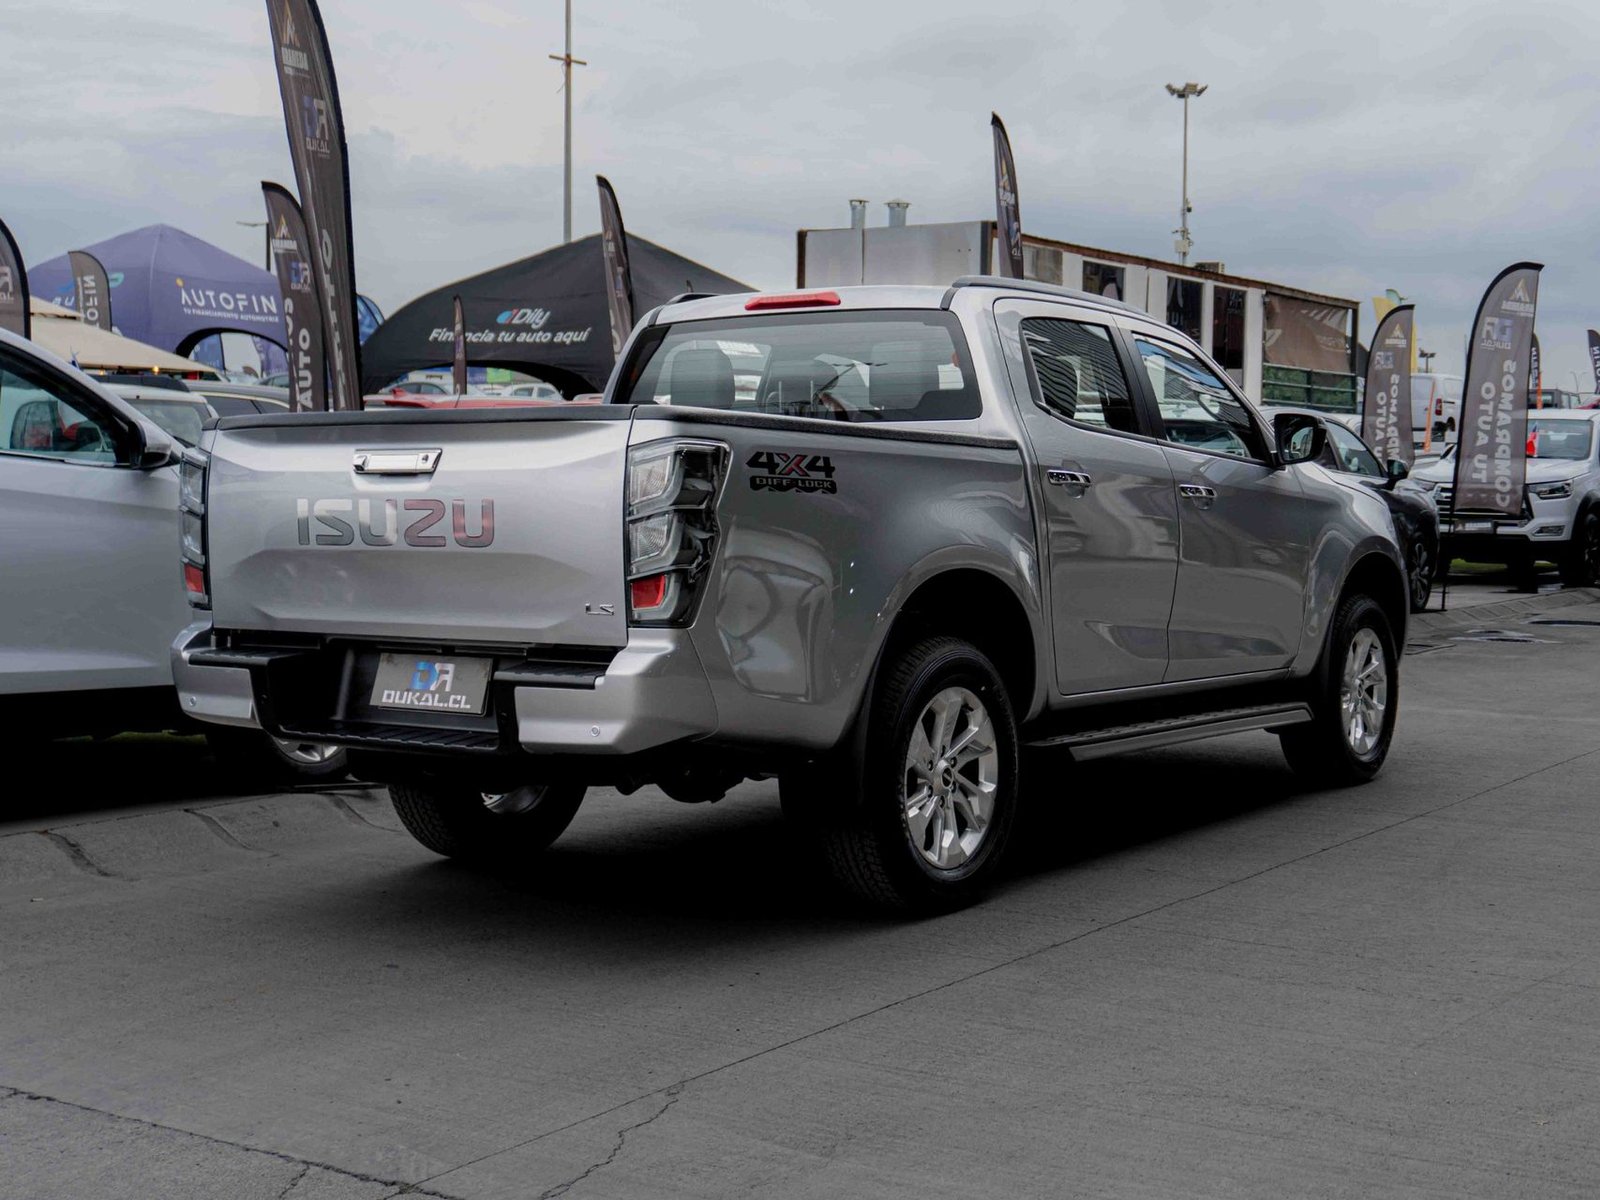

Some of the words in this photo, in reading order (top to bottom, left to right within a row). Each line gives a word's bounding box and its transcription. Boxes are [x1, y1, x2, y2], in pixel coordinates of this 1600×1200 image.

[180, 287, 278, 315] AUTOFIN
[429, 328, 494, 343] Finncia
[498, 329, 515, 342] tu
[518, 330, 551, 343] auto
[554, 327, 592, 346] aquí
[298, 327, 313, 410] AUTO
[296, 498, 494, 548] ISUZU
[585, 602, 615, 616] LS
[381, 689, 471, 709] DUKAL.CL
